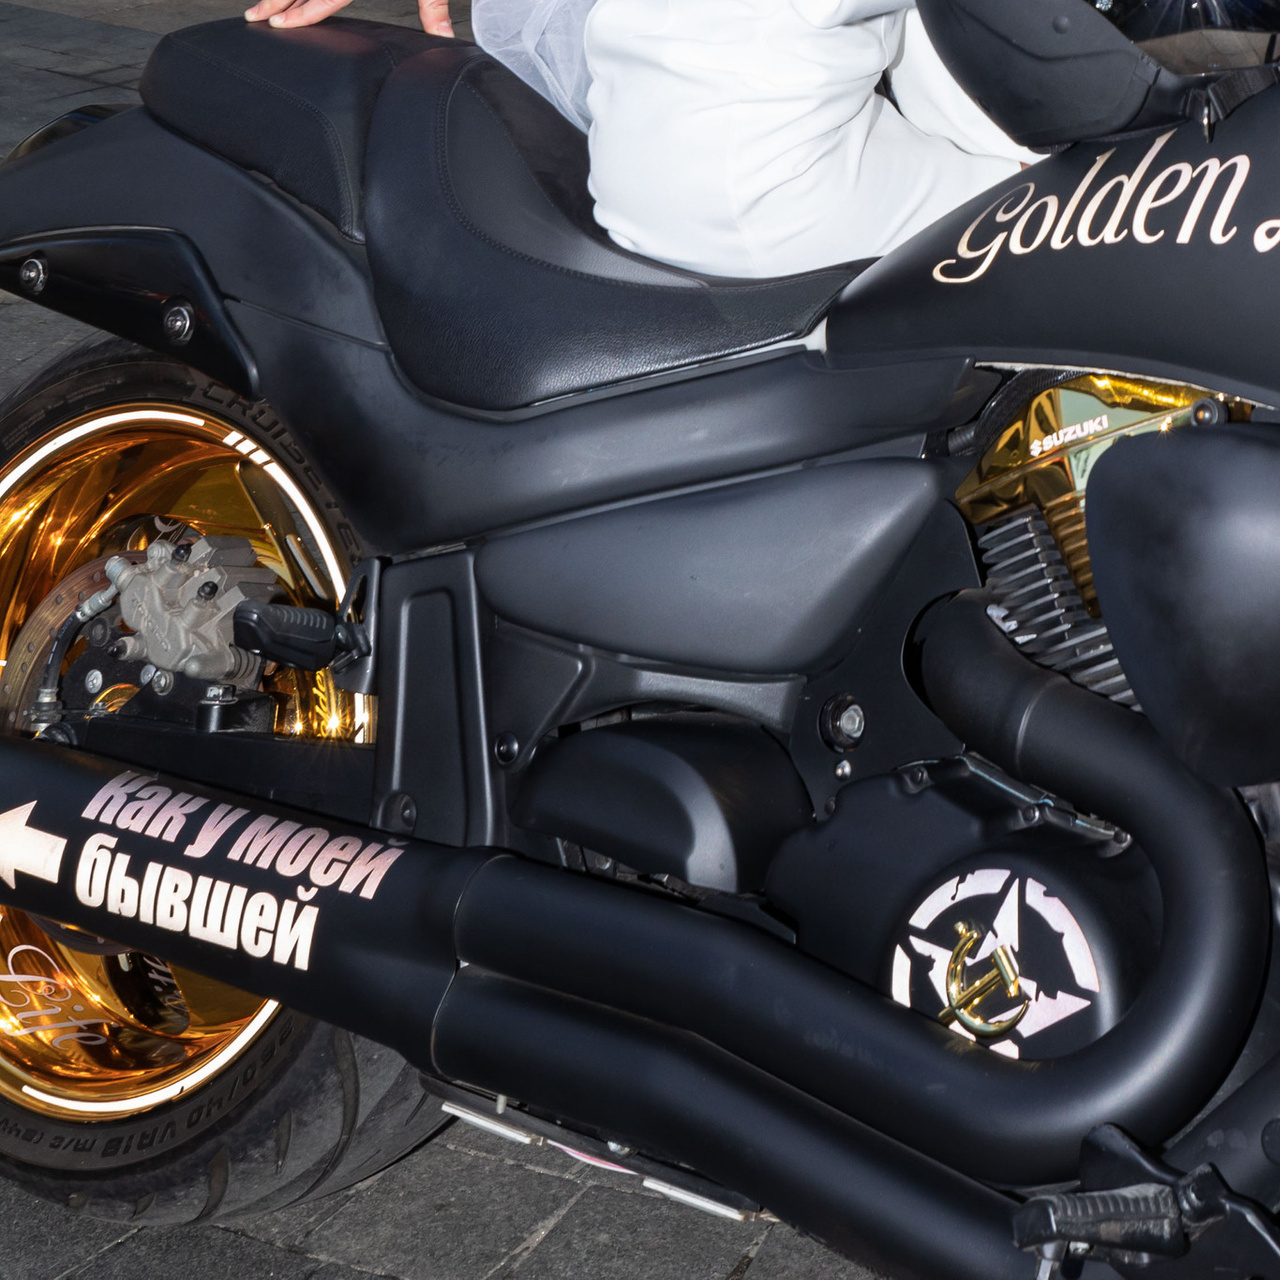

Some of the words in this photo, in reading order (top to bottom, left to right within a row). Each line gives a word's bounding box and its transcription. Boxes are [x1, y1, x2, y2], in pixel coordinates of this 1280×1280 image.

[932, 127, 1252, 284] Golden
[1042, 414, 1109, 454] SUZUKI
[75, 832, 320, 971] бывшей
[81, 770, 210, 842] Как
[227, 811, 410, 900] моей
